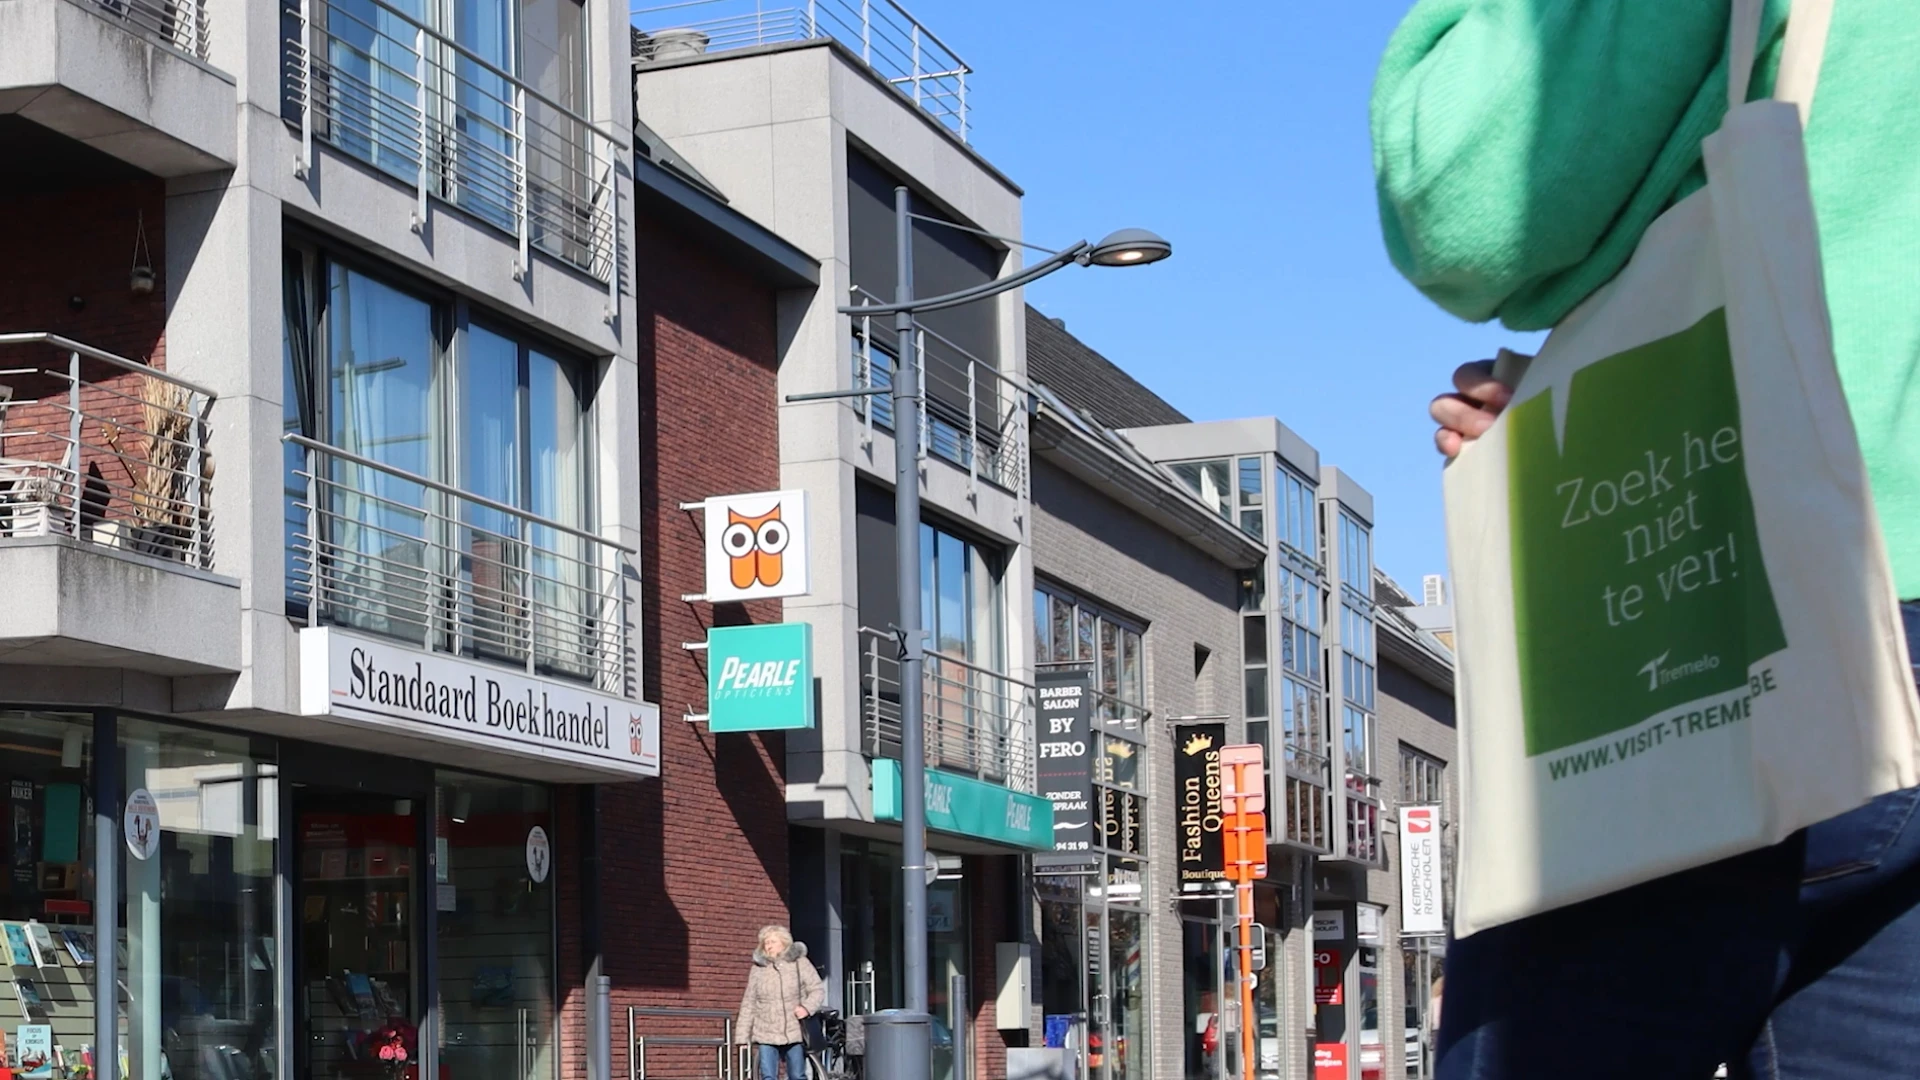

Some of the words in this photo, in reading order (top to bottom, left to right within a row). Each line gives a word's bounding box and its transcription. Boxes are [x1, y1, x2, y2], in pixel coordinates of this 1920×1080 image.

[1556, 449, 1675, 529] Zoek
[1622, 490, 1703, 565] niet
[1602, 584, 1644, 627] te
[1656, 532, 1740, 602] ver!
[717, 656, 801, 690] PEARLE
[350, 646, 478, 723] Standaard
[486, 679, 610, 750] Boekhandel
[714, 686, 793, 701] OPTICIENS
[1039, 686, 1083, 698] BARBER
[1043, 698, 1080, 710] SALON
[1049, 717, 1075, 734] BY
[1039, 741, 1086, 758] FERO
[1045, 791, 1082, 801] ZONDER
[1202, 750, 1224, 833] Queens
[1006, 794, 1032, 832] PEARLE
[1181, 776, 1202, 863] Fashion
[1056, 842, 1066, 851] 94
[1067, 842, 1077, 851] 31
[1078, 841, 1089, 850] 98
[1182, 869, 1226, 881] Boutique
[1410, 842, 1422, 915] KEMPISCHE
